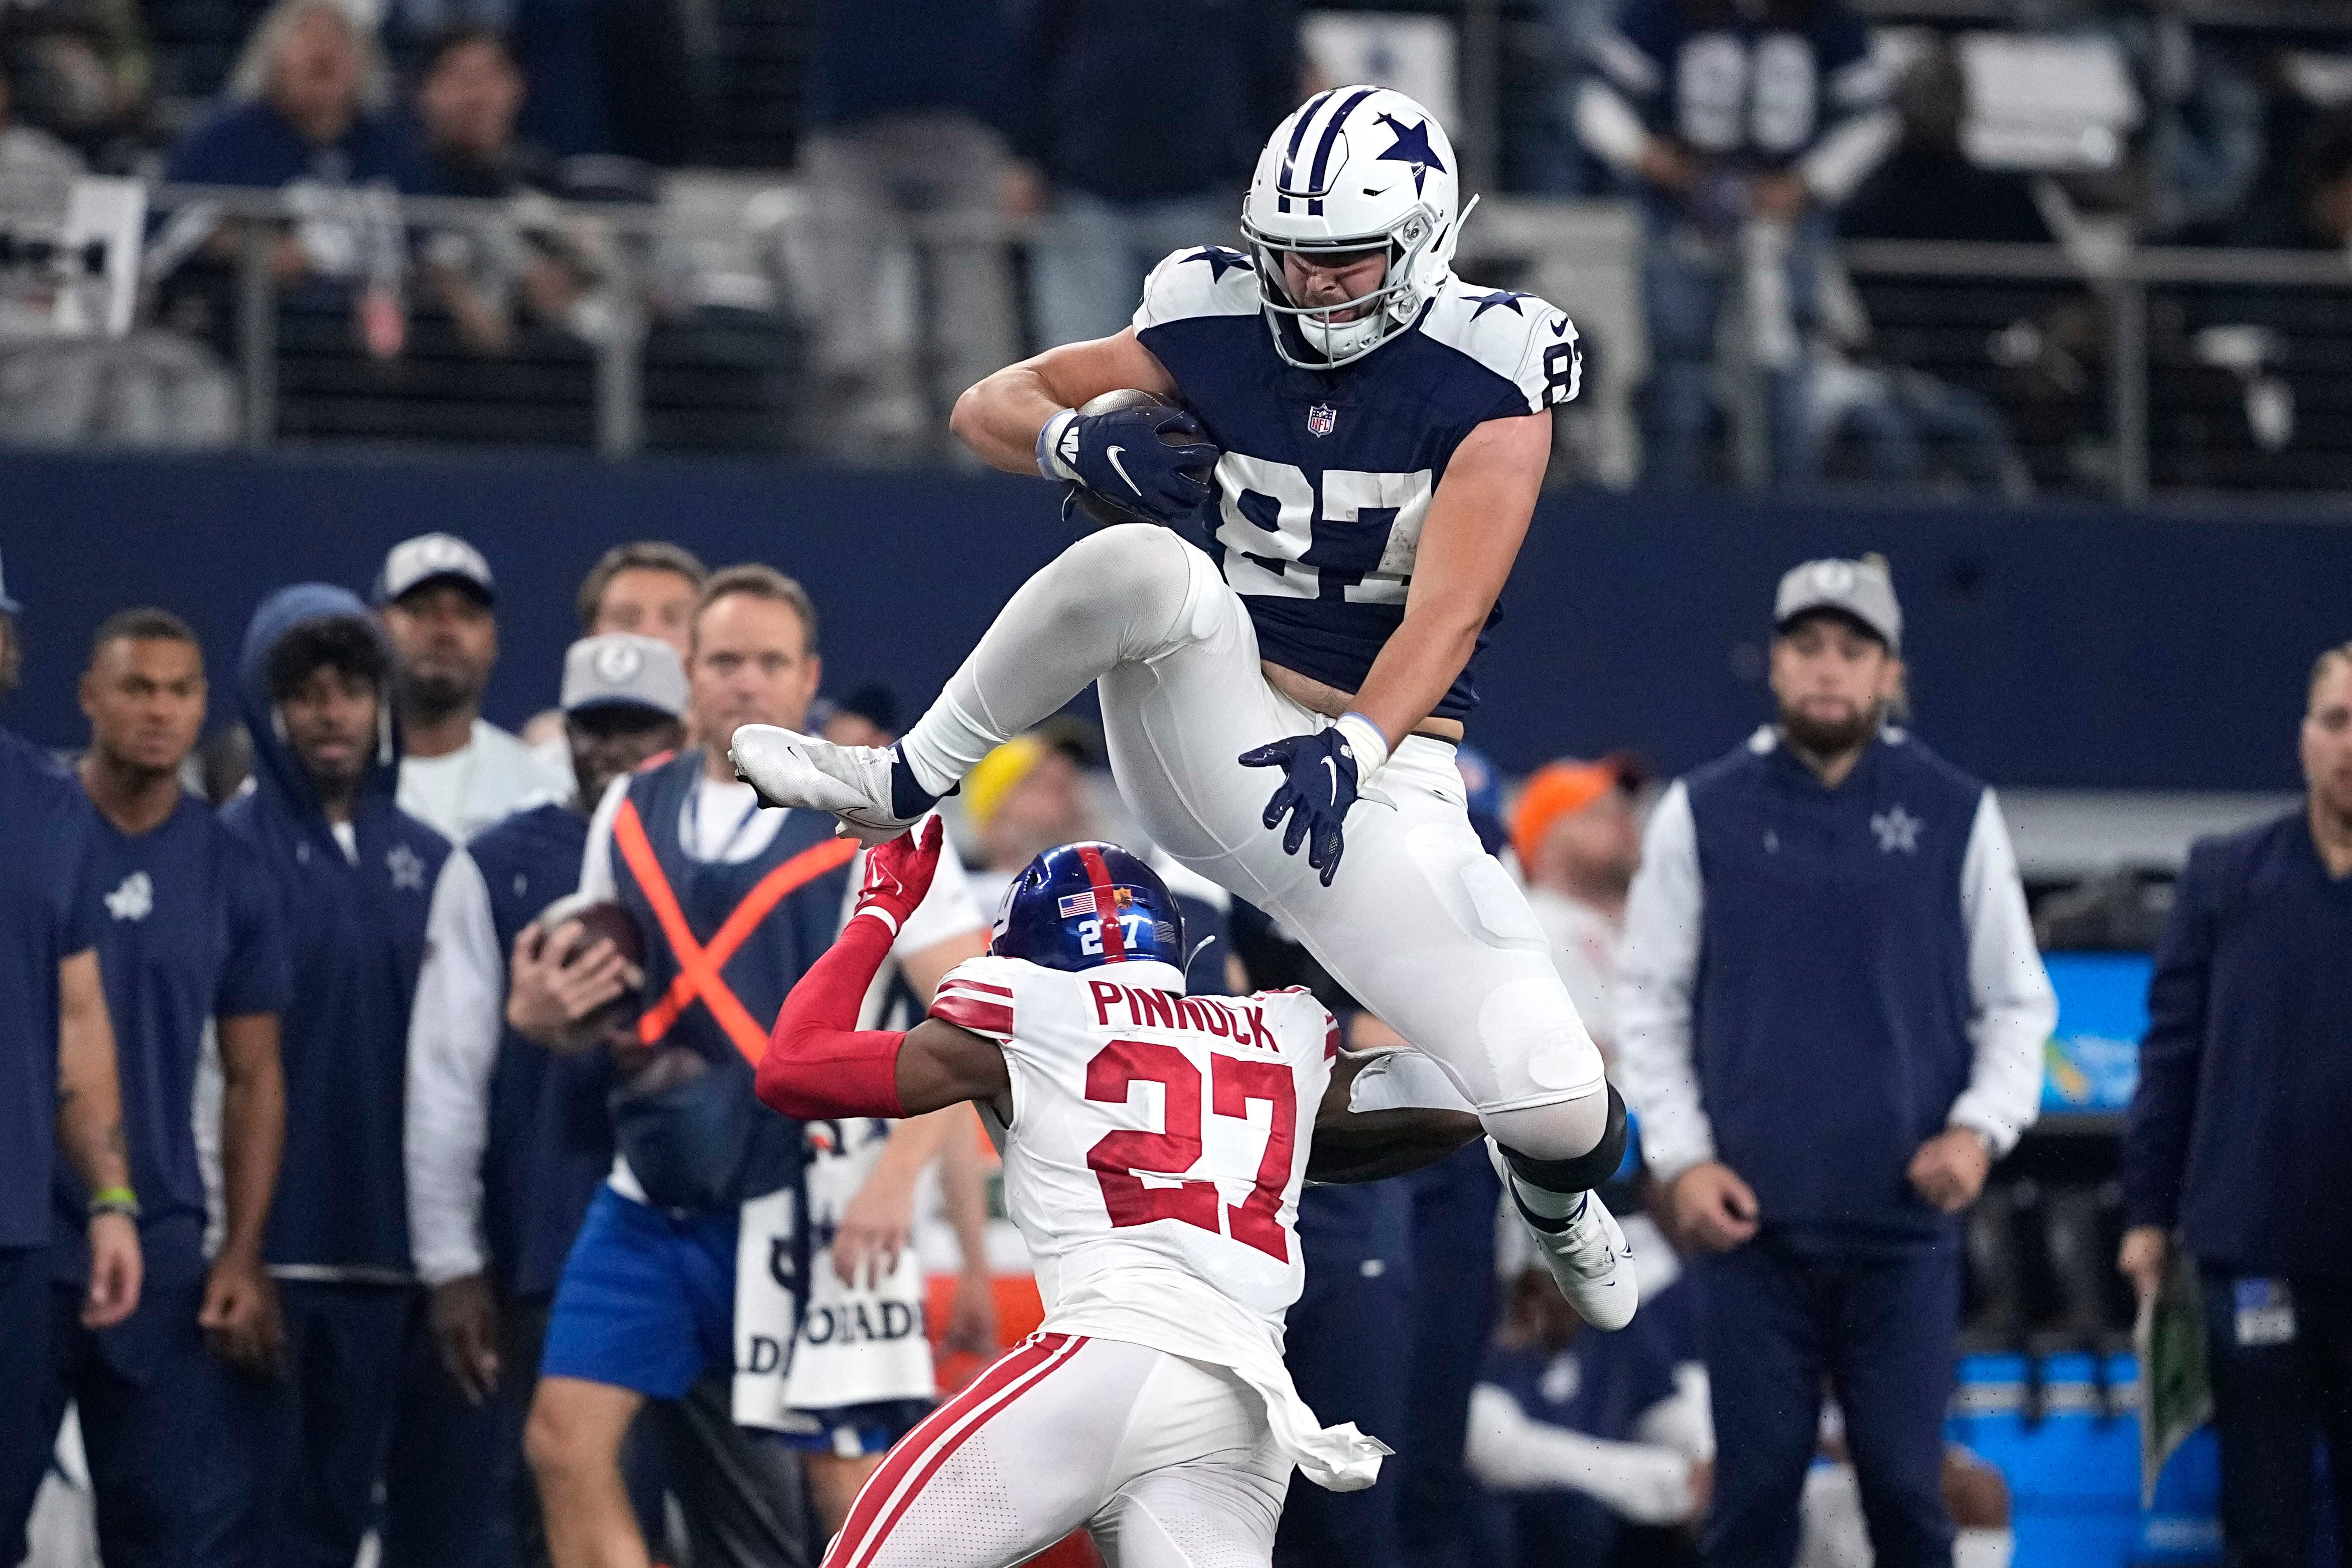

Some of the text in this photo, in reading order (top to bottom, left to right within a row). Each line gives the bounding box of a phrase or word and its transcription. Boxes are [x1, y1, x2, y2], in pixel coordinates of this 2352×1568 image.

[1311, 417, 1329, 431] NFL
[1214, 451, 1432, 605] 87
[1078, 914, 1141, 955] 27
[1088, 980, 1280, 1053] PINNOCK
[1084, 1039, 1297, 1265] 27
